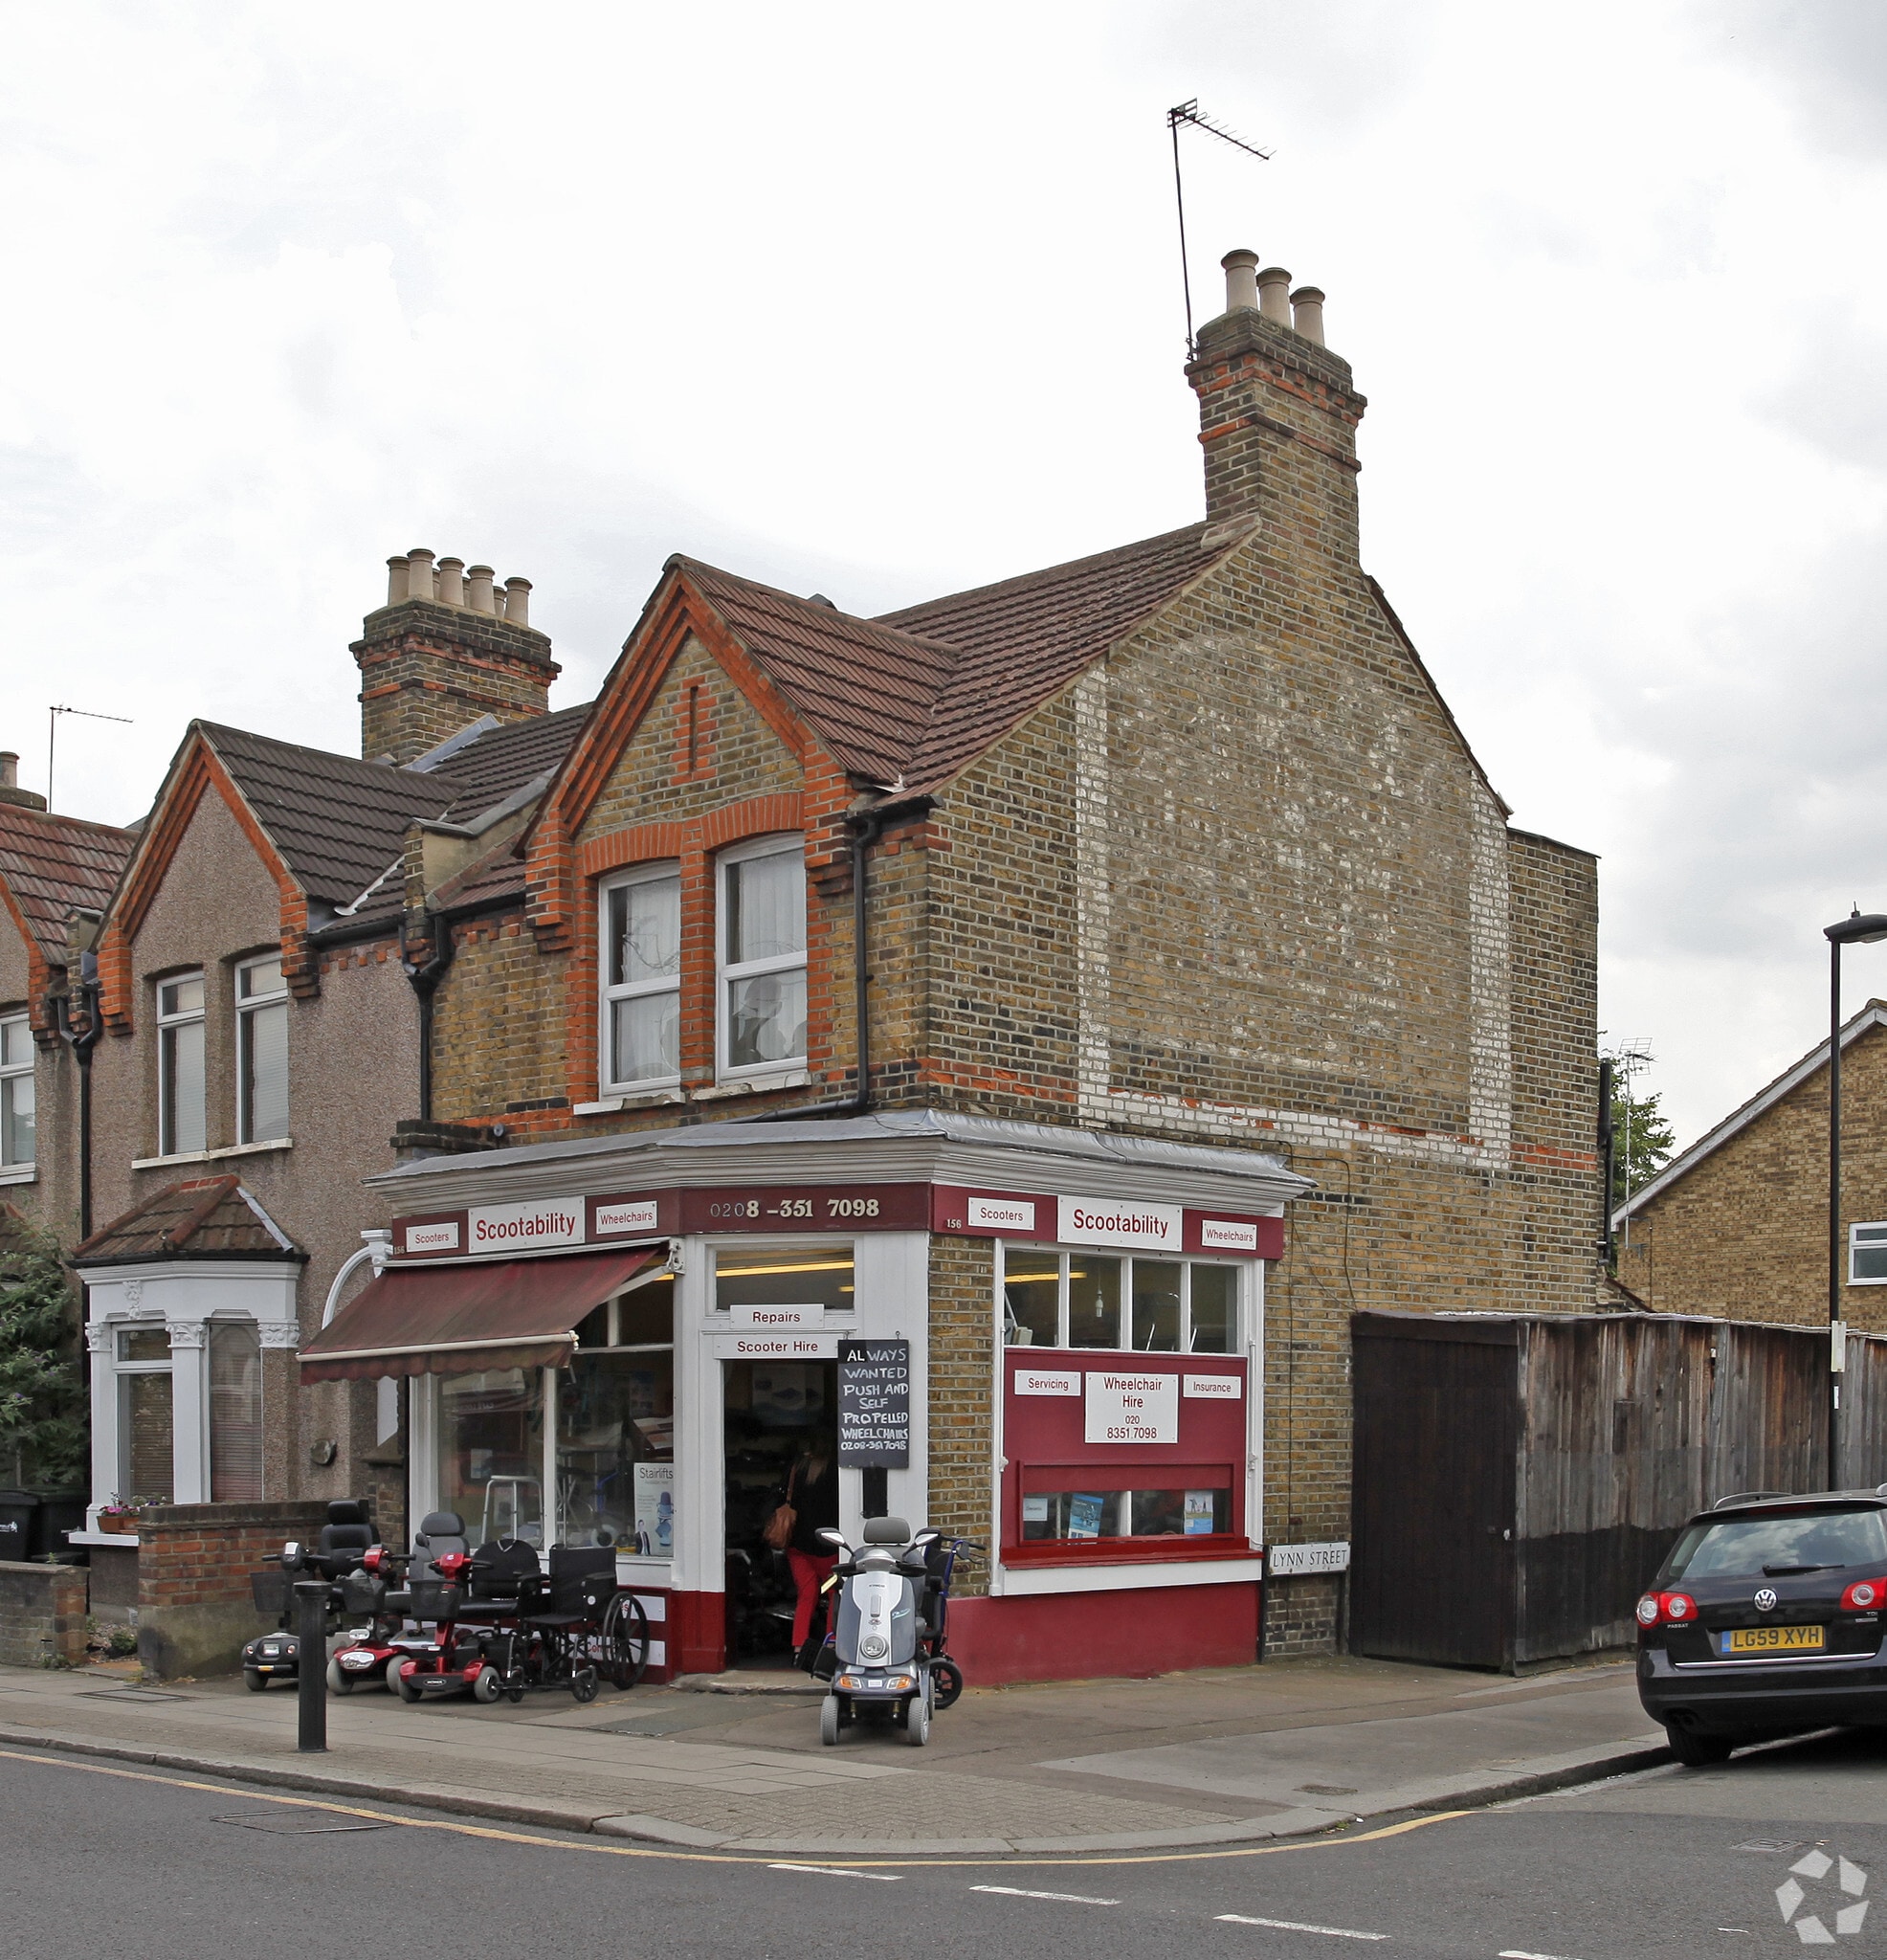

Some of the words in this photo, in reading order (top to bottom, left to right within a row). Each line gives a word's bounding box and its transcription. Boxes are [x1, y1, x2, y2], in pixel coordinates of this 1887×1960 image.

[710, 1200, 760, 1218] 0208
[827, 1198, 879, 1217] 7098
[980, 1207, 1024, 1221] Scooters
[600, 1210, 653, 1225] Wheelchairs
[946, 1218, 962, 1229] 156
[1073, 1209, 1168, 1238] Scootability
[476, 1212, 576, 1241] Scootability
[414, 1231, 450, 1244] Scooters
[1206, 1228, 1254, 1242] Wheelchairs
[752, 1311, 801, 1325] Repairs
[737, 1341, 788, 1352] Scooter
[793, 1341, 818, 1351] Hire
[847, 1348, 906, 1362] ALWAYS
[844, 1368, 907, 1379] WANTED
[843, 1385, 880, 1396] PUSH
[884, 1383, 909, 1395] AND
[1028, 1377, 1069, 1392] Servicing
[1103, 1376, 1162, 1391] Wheelchair
[1193, 1380, 1232, 1392] Insurance
[859, 1398, 889, 1410] SELF
[1122, 1395, 1143, 1408] Hire
[842, 1413, 908, 1424] PROPELLED
[1125, 1415, 1140, 1424] 020
[841, 1428, 908, 1440] WHEELCHAIRS
[639, 1467, 674, 1480] Stairlifts
[1273, 1552, 1304, 1567] LYNN
[1309, 1549, 1347, 1566] STREET
[1734, 1630, 1779, 1648] LG59
[1785, 1627, 1819, 1645] XYH
